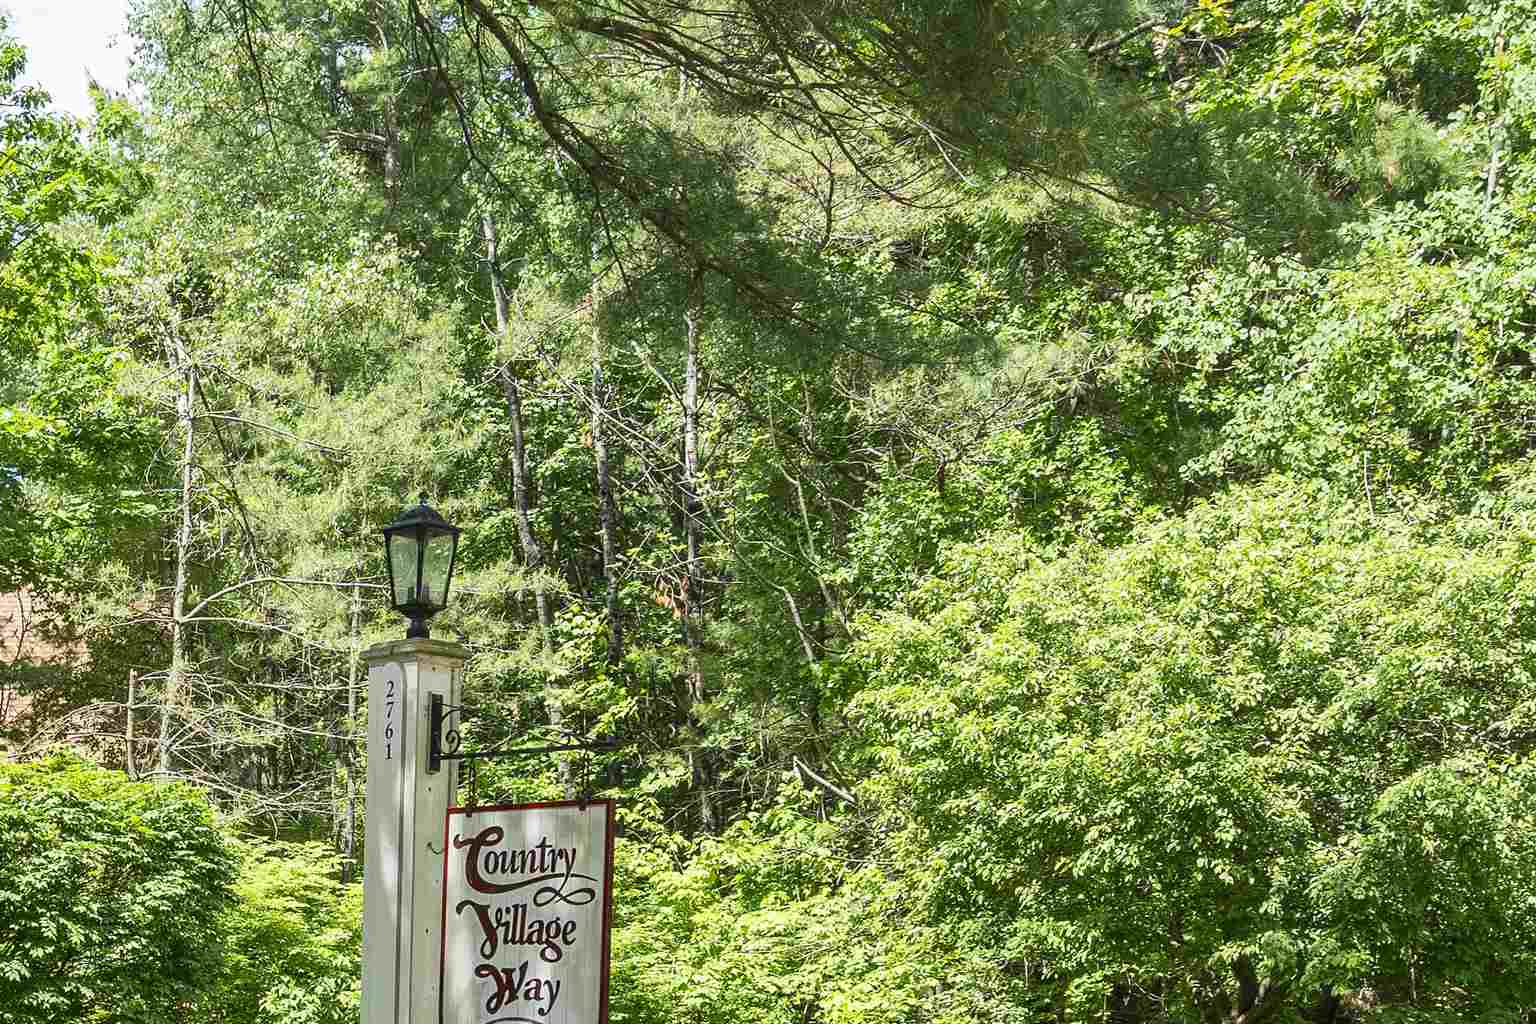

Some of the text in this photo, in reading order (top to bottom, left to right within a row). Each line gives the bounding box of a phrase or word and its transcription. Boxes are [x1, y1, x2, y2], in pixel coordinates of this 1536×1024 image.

[384, 680, 395, 760] 2761
[453, 825, 598, 907] Country
[455, 899, 577, 963] Village
[474, 960, 561, 1017] Way
